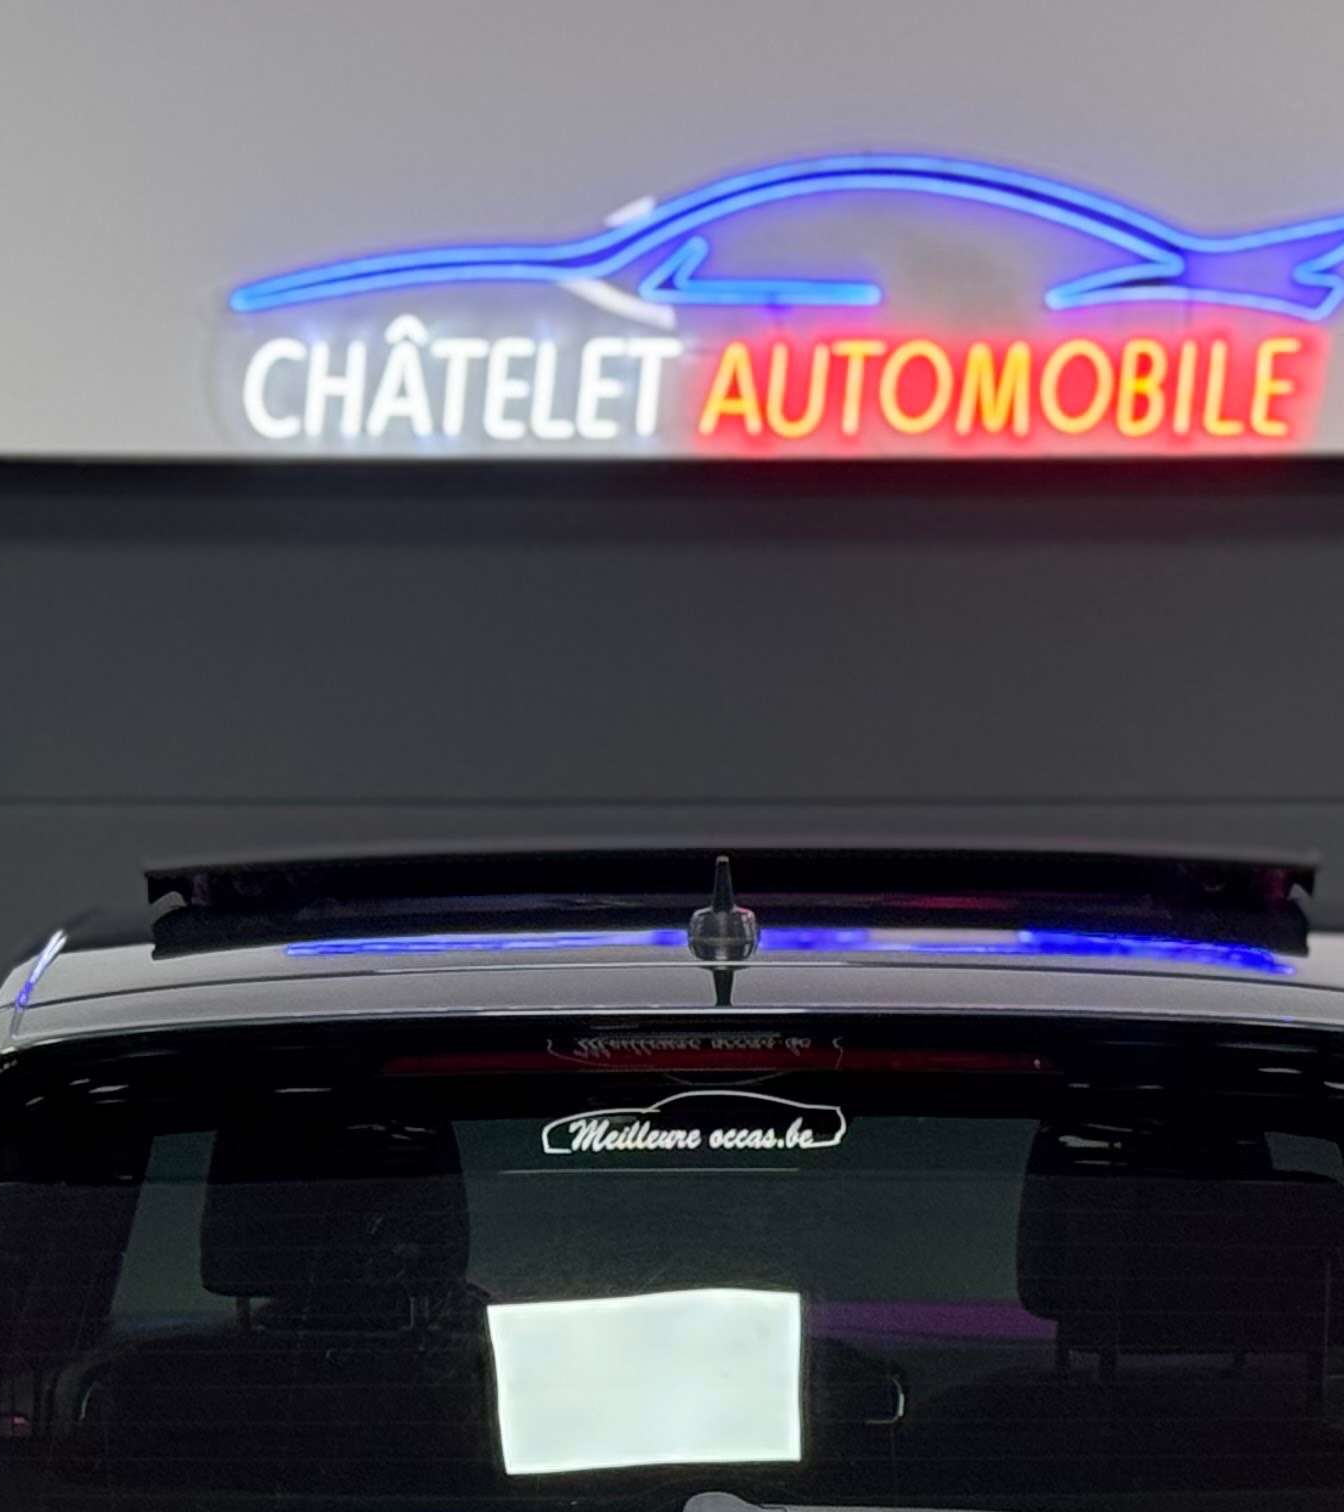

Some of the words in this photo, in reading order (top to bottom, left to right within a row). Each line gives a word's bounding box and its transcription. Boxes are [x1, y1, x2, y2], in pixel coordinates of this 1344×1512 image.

[243, 312, 680, 440] CHÂTELET
[697, 334, 1302, 440] AUTOMOBILE
[568, 1119, 701, 1151] Meilleure
[709, 1117, 813, 1149] occas.be
